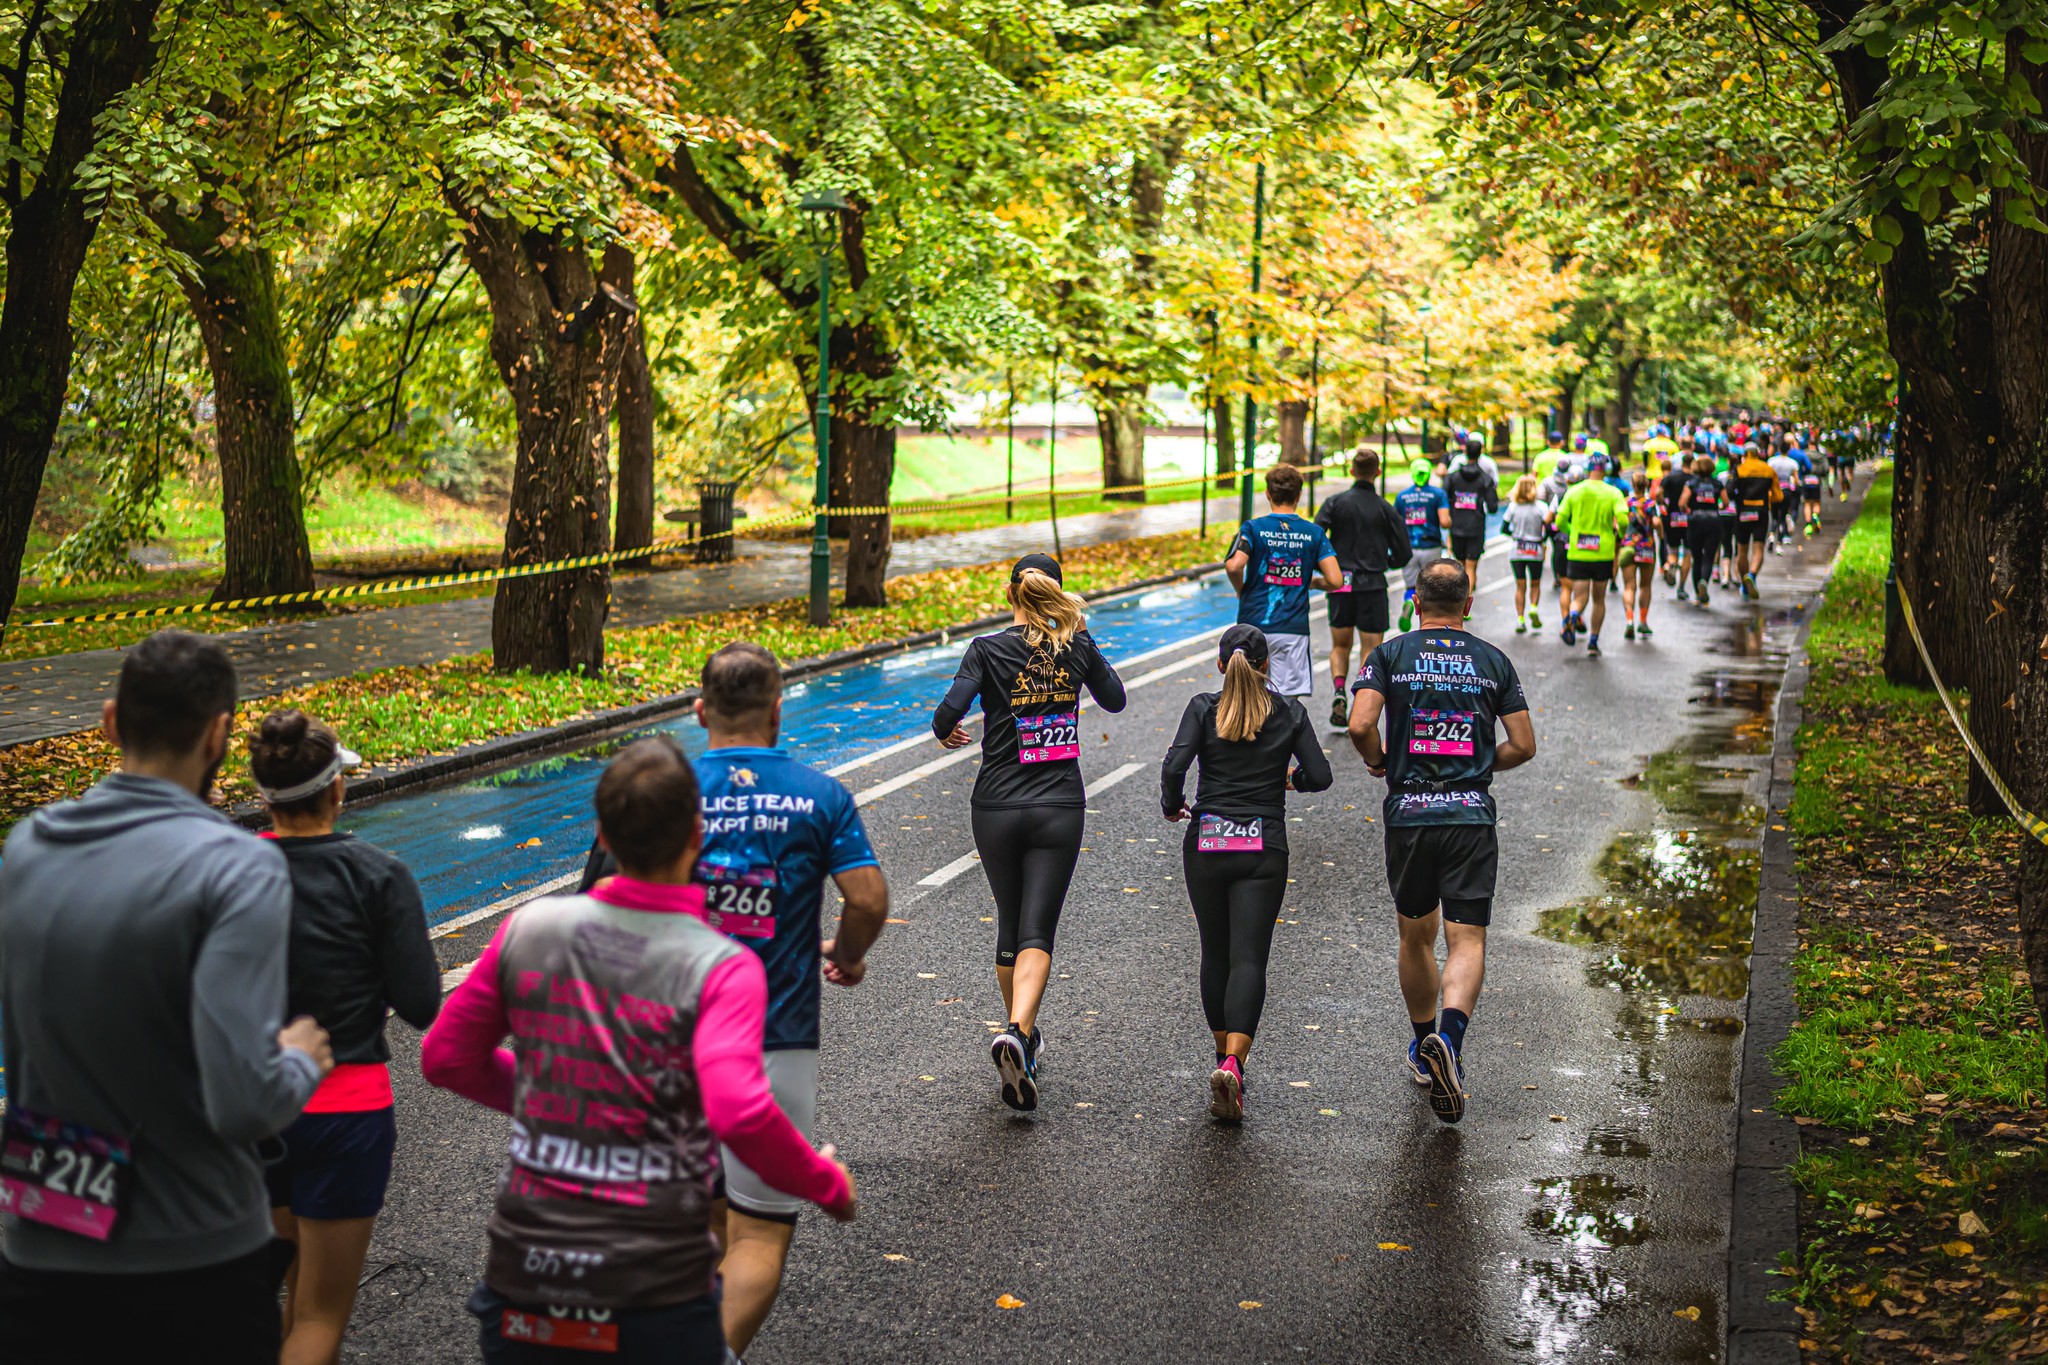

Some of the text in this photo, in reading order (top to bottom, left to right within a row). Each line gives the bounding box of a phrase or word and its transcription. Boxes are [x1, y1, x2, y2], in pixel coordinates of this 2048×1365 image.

[1260, 531, 1311, 541] POLICE TEAM
[1267, 540, 1288, 548] DKPT
[1281, 566, 1301, 578] 265
[1415, 659, 1476, 676] ULTRA
[1410, 682, 1423, 691] 6H
[1434, 683, 1451, 691] 12H
[1462, 684, 1481, 694] 24H
[1010, 696, 1030, 706] NOVI
[1031, 695, 1048, 703] SAD
[1043, 726, 1077, 747] 222
[1436, 722, 1472, 742] 242
[1413, 741, 1426, 752] 6H
[1023, 750, 1036, 761] 6H
[701, 794, 814, 814] LICE TEAM
[1223, 820, 1259, 837] 246
[1201, 839, 1214, 849] 6H
[719, 884, 772, 916] 266
[45, 1149, 117, 1204] 214
